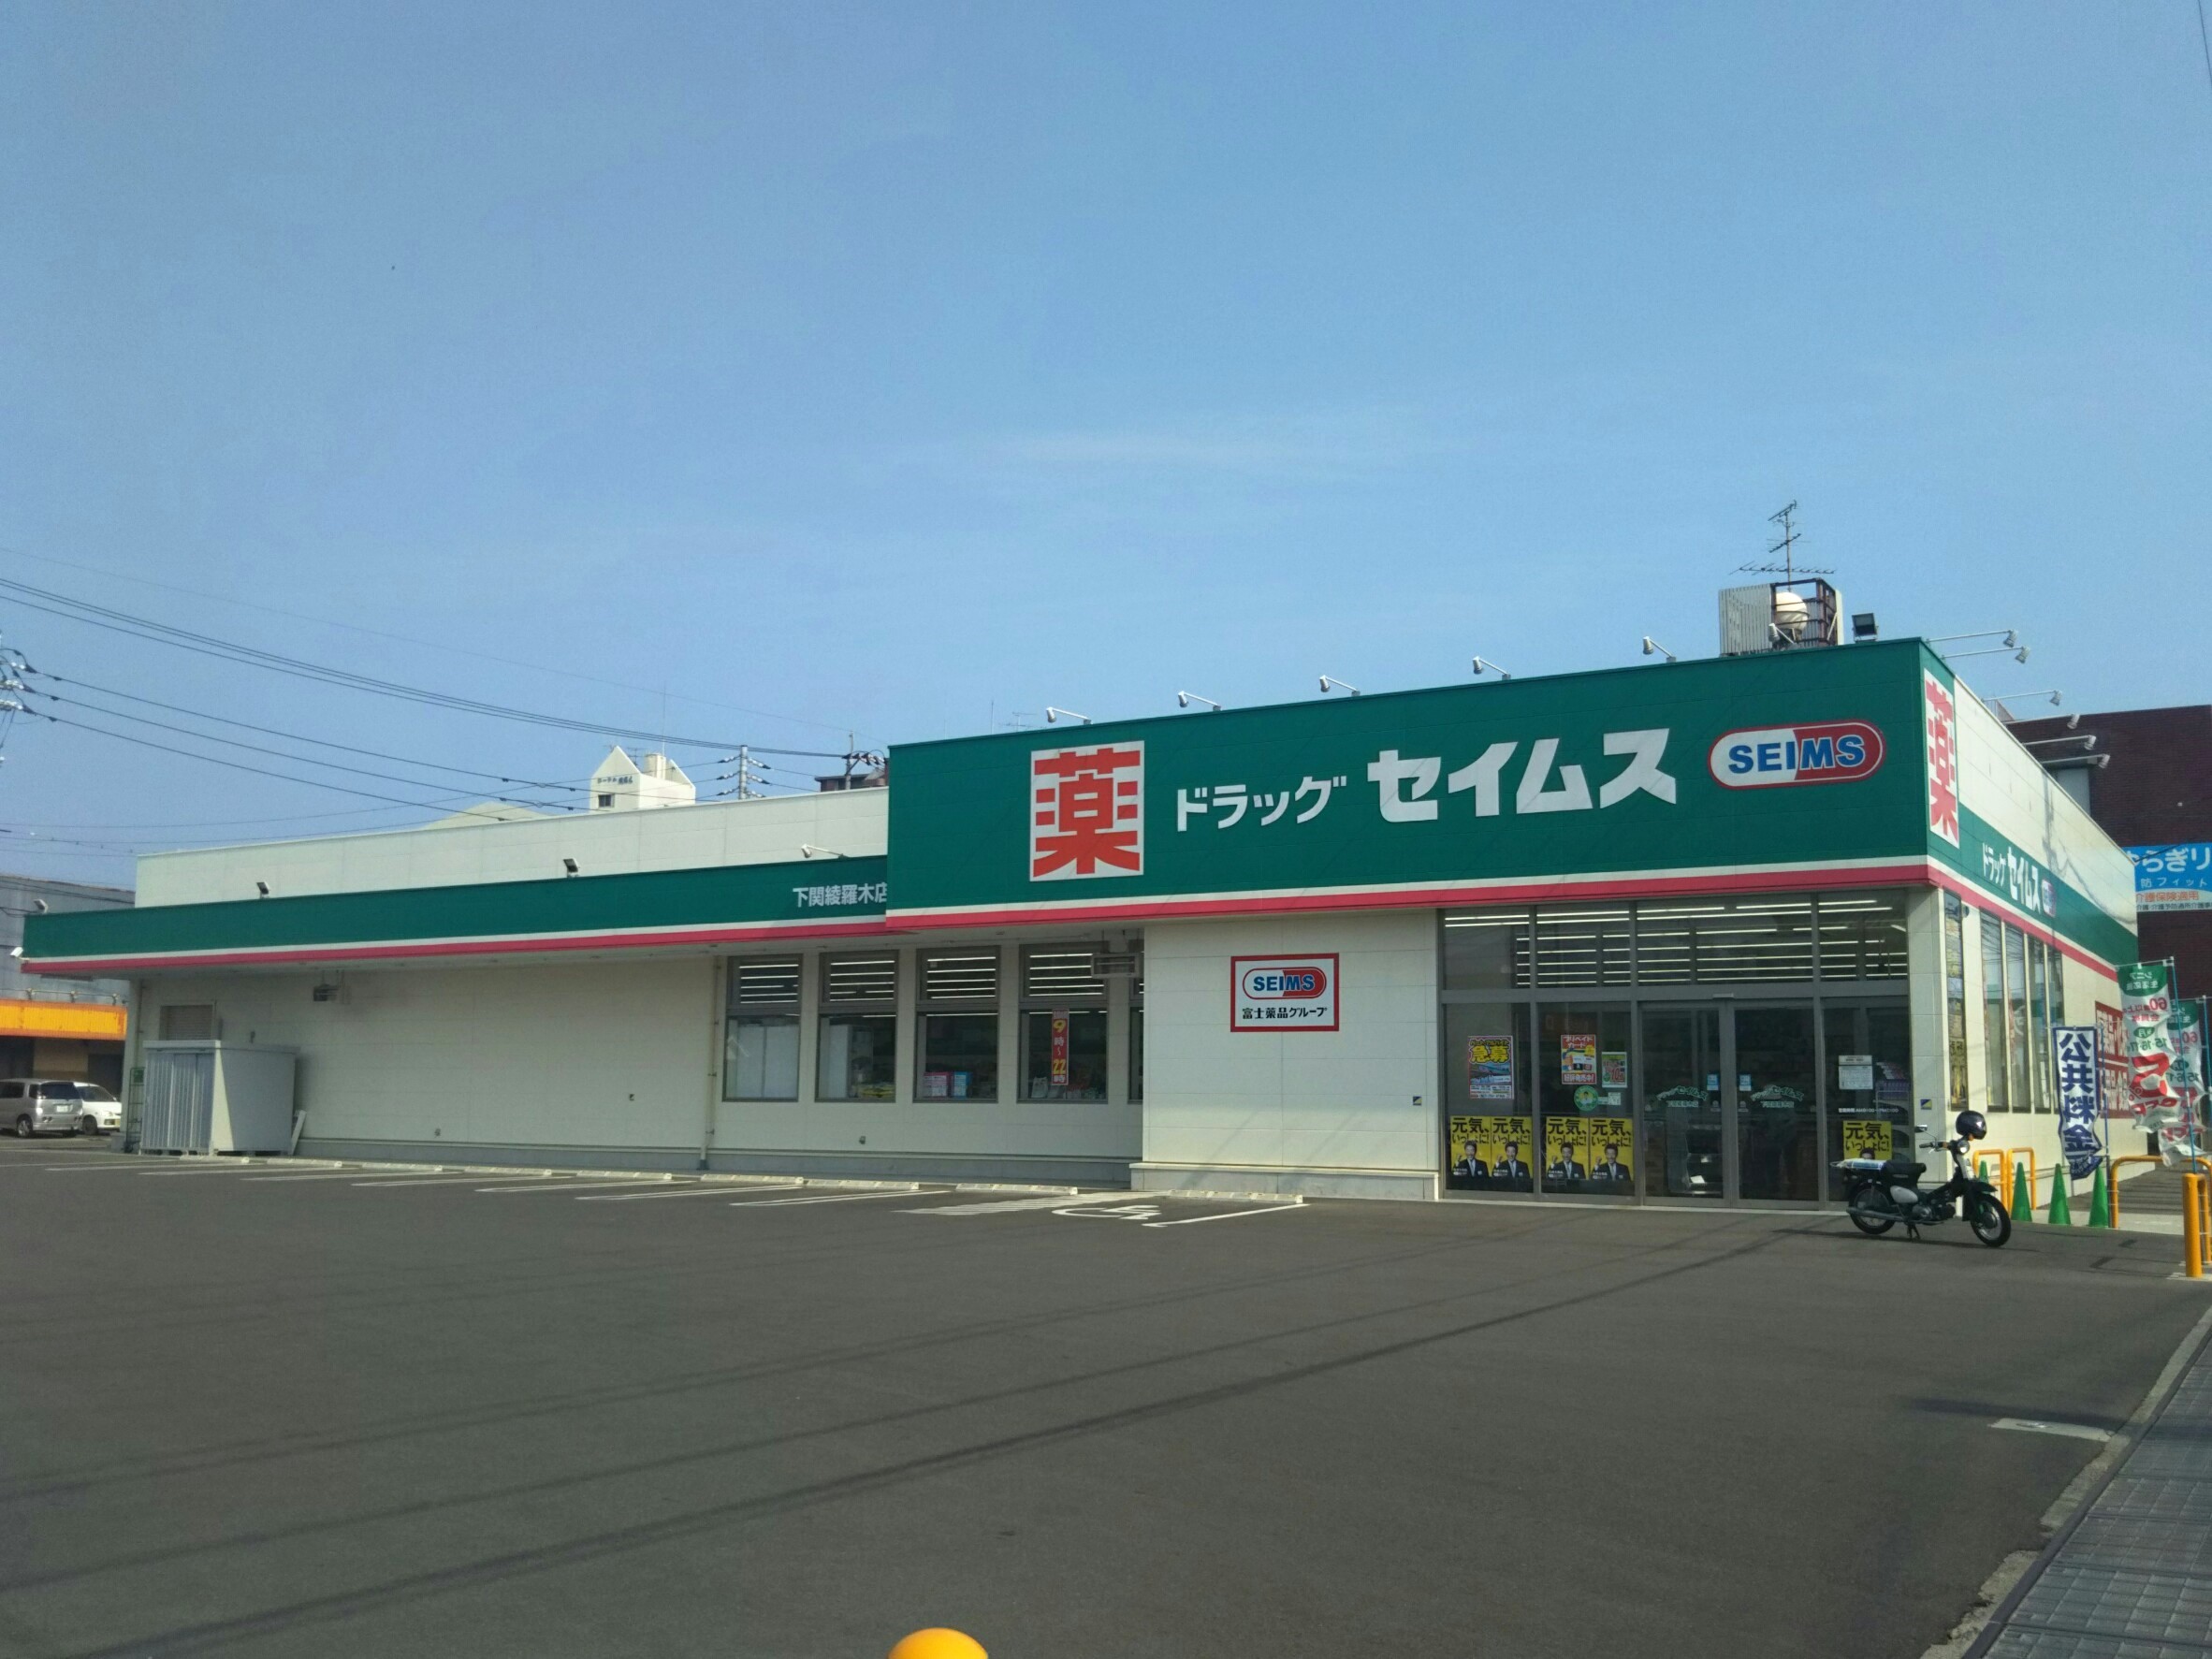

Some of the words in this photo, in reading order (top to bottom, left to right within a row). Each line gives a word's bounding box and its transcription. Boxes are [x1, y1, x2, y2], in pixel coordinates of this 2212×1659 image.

[1728, 735, 1866, 775] SEIMS
[1925, 678, 1958, 843] 薬
[1176, 775, 1347, 832] ドラッグ
[1367, 728, 1678, 823] セイムス
[1033, 748, 1141, 877] 薬
[2007, 846, 2042, 915] セイムス
[793, 881, 888, 908] 下関綾羅木店
[1253, 974, 1316, 992] SEIMS
[1242, 1007, 1328, 1019] 富士薬品グループ
[1452, 1117, 1490, 1133] 元気、
[1492, 1118, 1531, 1134] 元気、
[1548, 1118, 1587, 1135] 元気、
[1592, 1119, 1632, 1136] 元気、
[1845, 1122, 1889, 1140] 元気、
